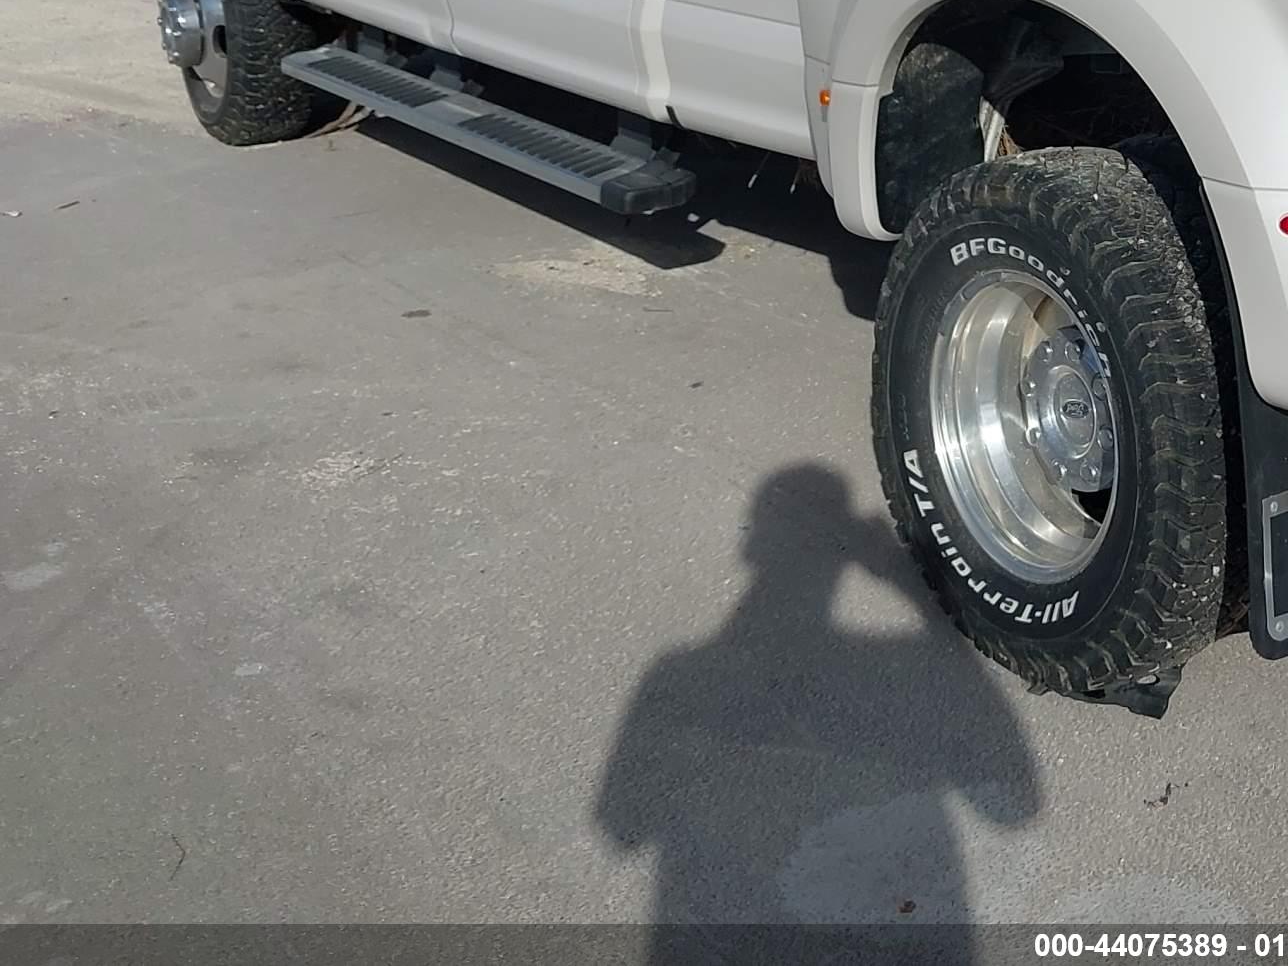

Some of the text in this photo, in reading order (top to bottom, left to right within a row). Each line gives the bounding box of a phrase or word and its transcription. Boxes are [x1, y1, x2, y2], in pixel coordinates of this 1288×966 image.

[949, 237, 1112, 378] BFGoodrich
[903, 449, 1080, 625] All-Terrain T/A
